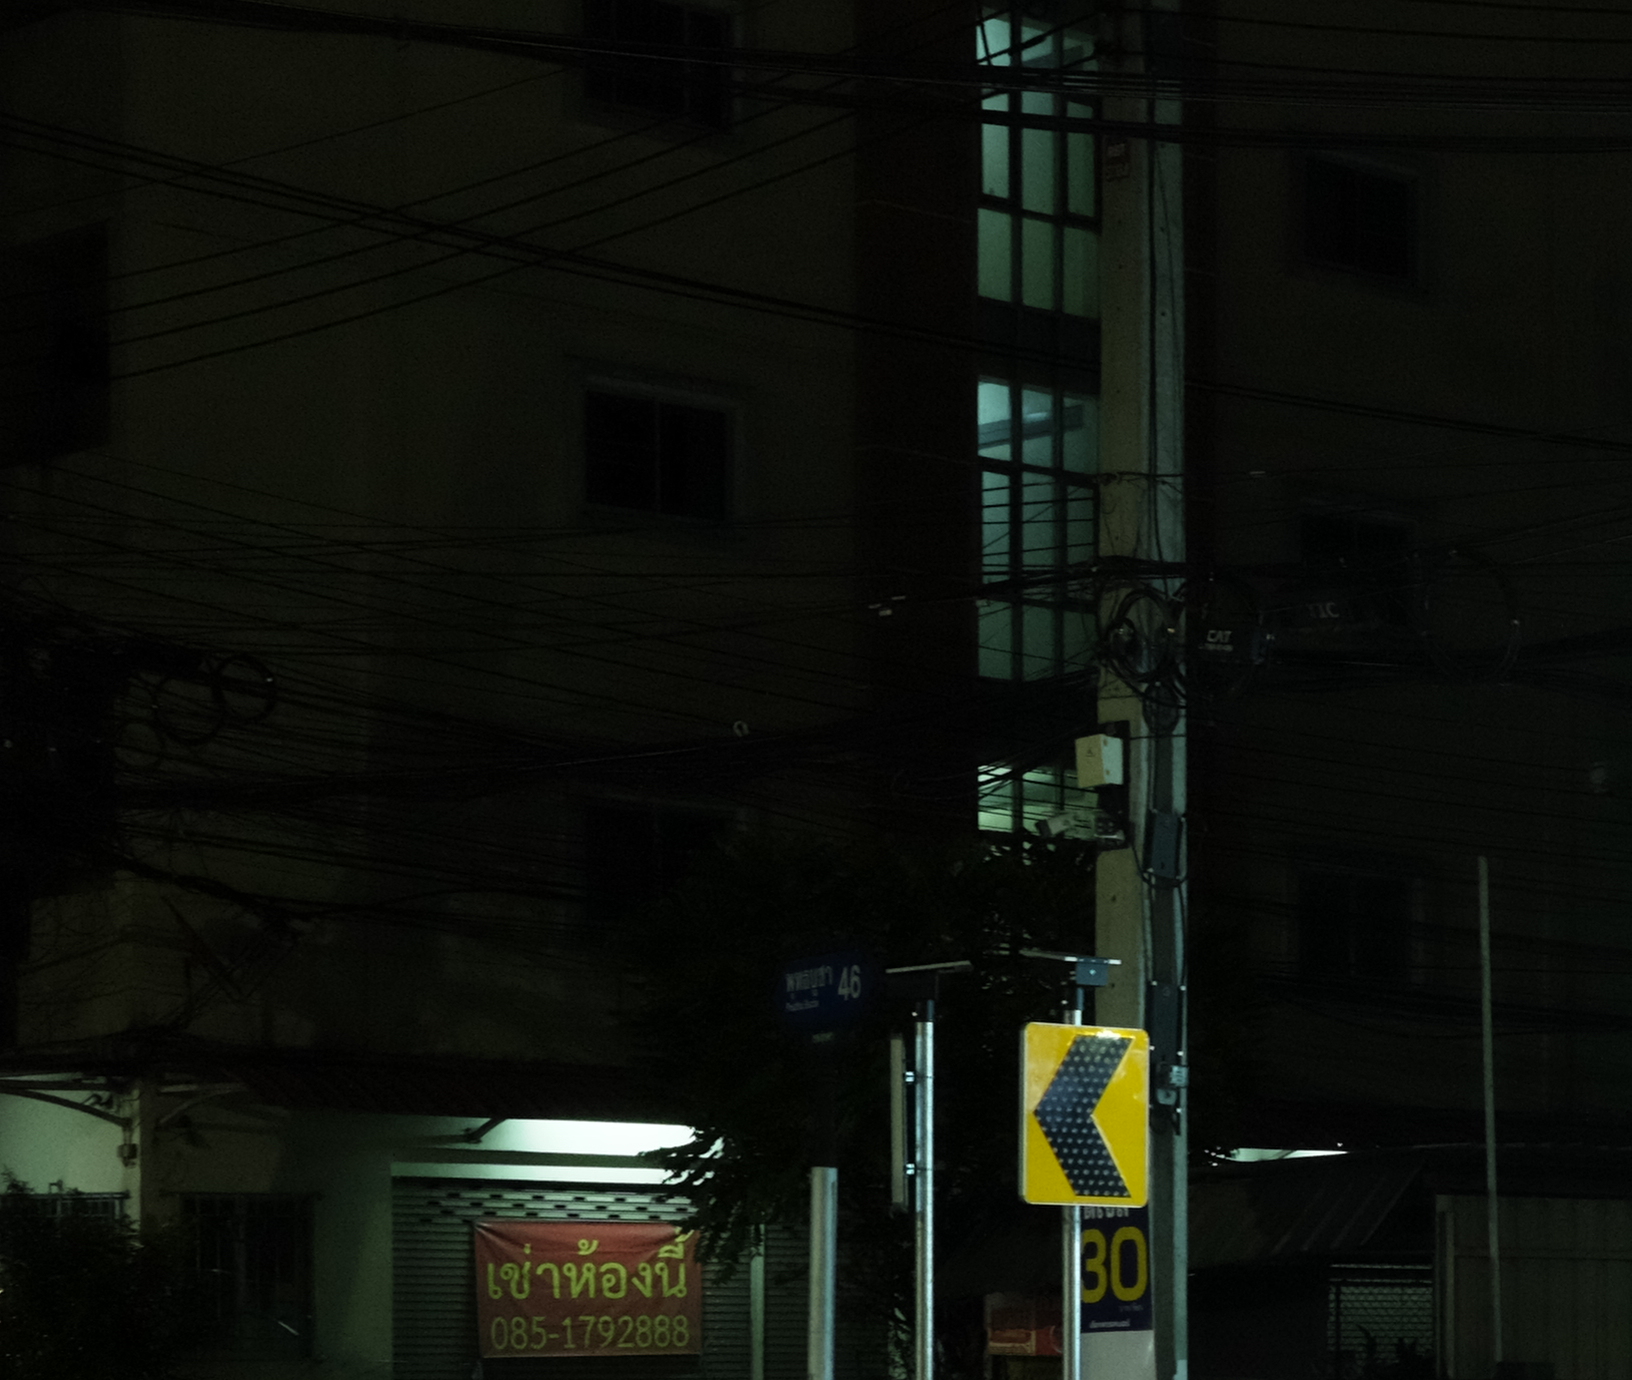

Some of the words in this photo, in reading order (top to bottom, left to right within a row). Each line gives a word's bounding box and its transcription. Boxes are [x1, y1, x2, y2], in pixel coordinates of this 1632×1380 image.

[838, 964, 862, 1001] 46
[486, 1230, 696, 1301] เช่าห้องนี้
[1081, 1225, 1149, 1305] 30
[490, 1316, 691, 1350] 085-1792888
